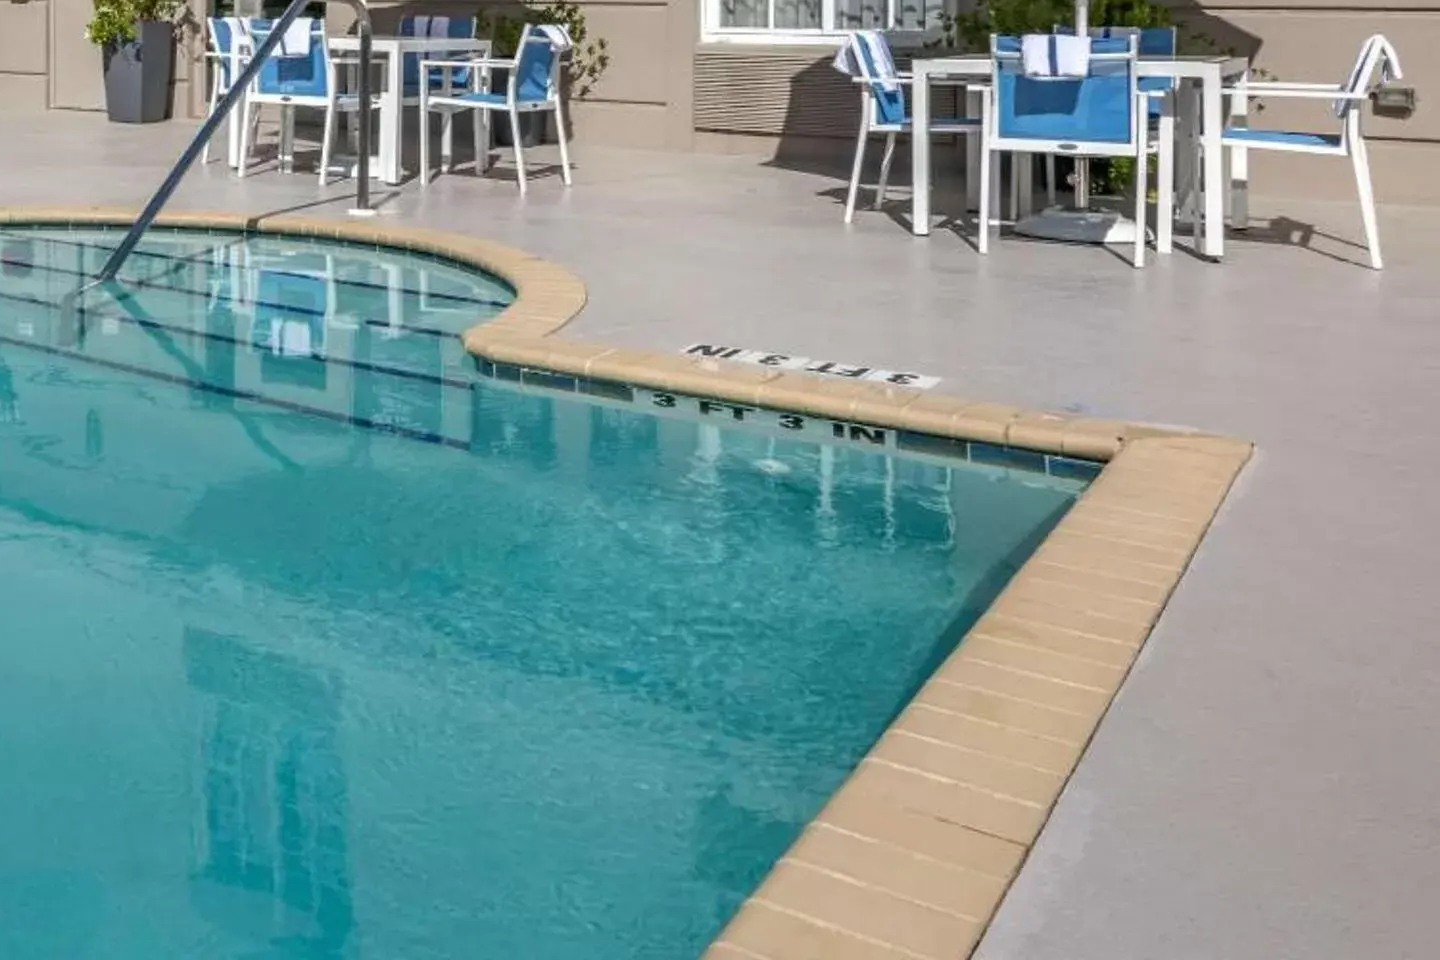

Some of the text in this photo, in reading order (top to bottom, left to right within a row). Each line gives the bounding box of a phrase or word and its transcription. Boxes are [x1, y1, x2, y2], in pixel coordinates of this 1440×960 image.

[687, 345, 920, 385] 3 FT 3 IN
[652, 393, 885, 444] 3 FT 3 IN
